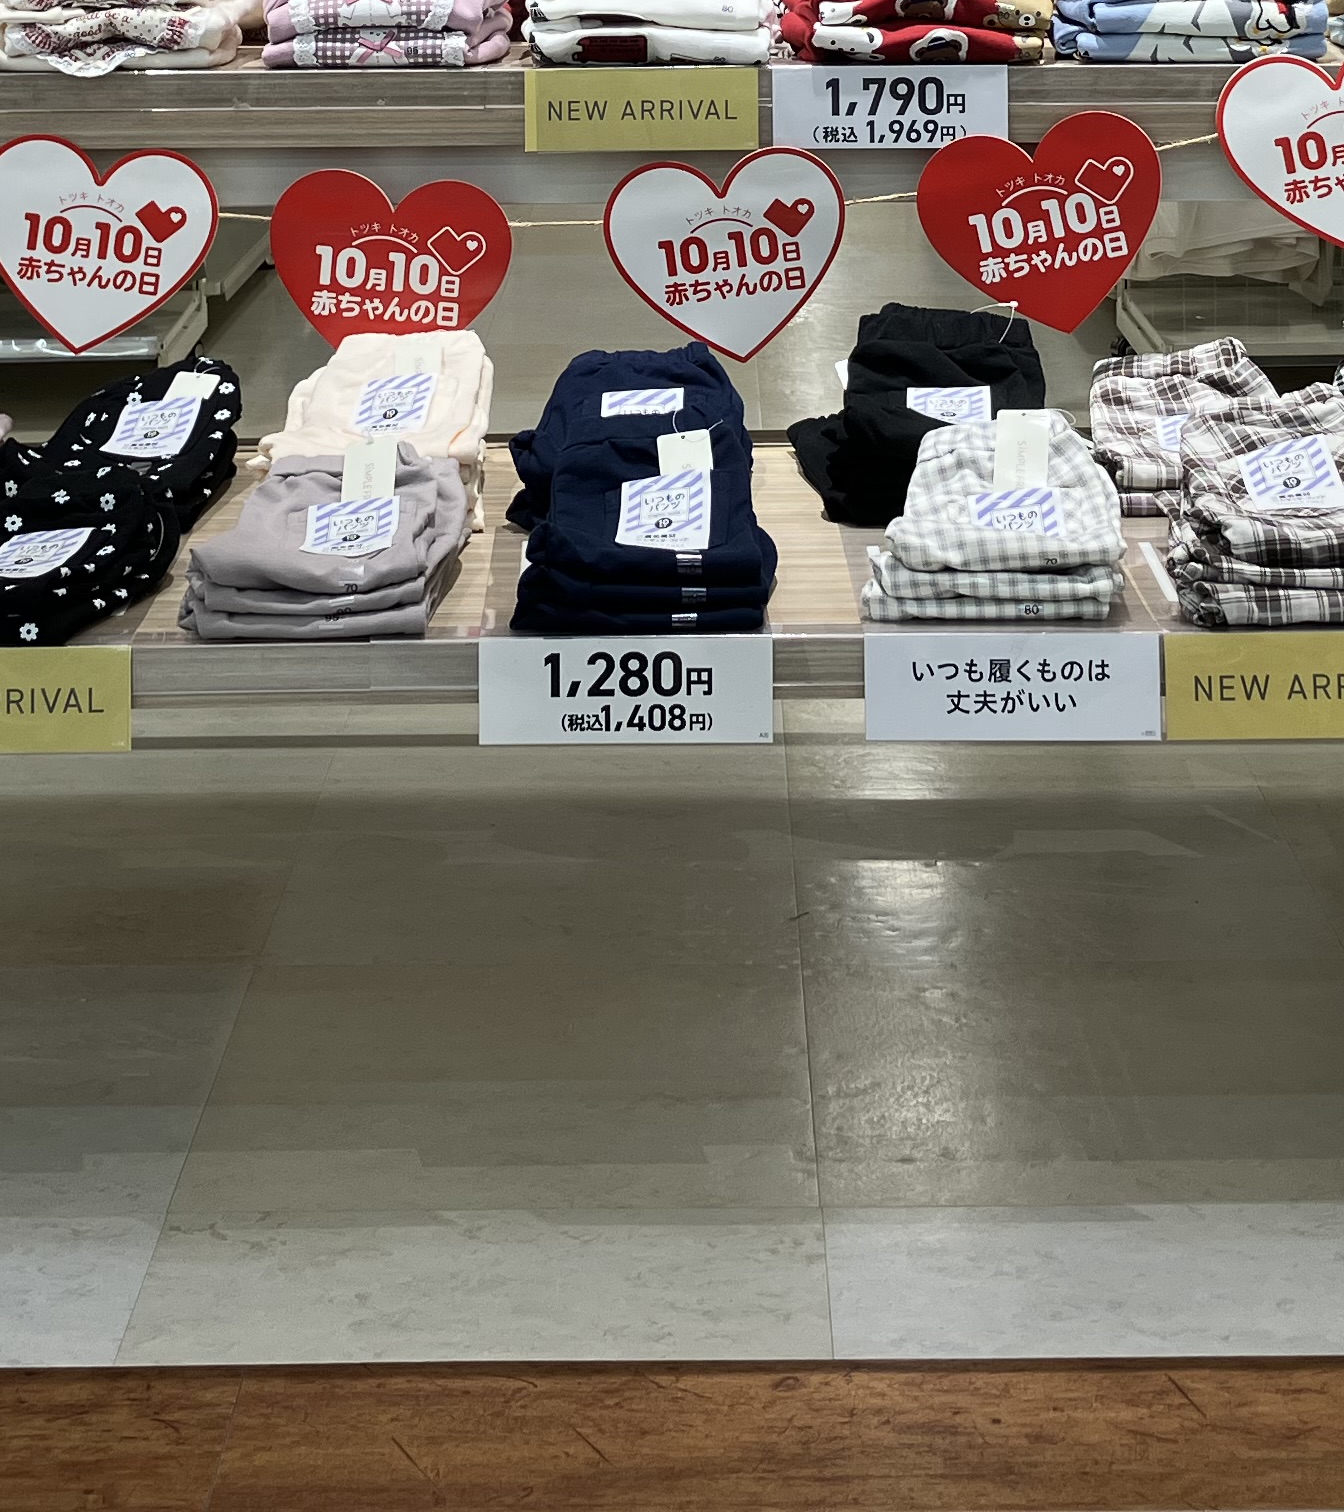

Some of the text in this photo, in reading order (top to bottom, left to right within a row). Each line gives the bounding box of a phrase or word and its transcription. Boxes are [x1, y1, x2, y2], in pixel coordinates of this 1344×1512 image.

[547, 98, 738, 123] NEW ARRIVAL
[824, 76, 966, 117] 1,790円
[812, 126, 858, 144] (税込
[968, 192, 1121, 254] 10月10日
[24, 211, 162, 267] 10月10日
[658, 227, 800, 277] 10月10日
[315, 245, 460, 298] 10月10日
[979, 231, 1129, 285] 赤ちゃんの日
[17, 256, 160, 296] 赤ちゃんの日
[664, 266, 806, 306] 赤ちゃんの日
[310, 290, 459, 327] 赤ちゃんの日
[644, 492, 685, 504] いつもの
[649, 500, 680, 512] パンツ
[333, 515, 375, 526] いつもの
[996, 511, 1037, 523] いつもの
[344, 583, 358, 592] 70
[1024, 604, 1039, 615] 80
[543, 651, 713, 698] 1,280円
[911, 658, 1111, 684] いつも履くものは
[945, 689, 1079, 715] 丈夫がいい
[1193, 674, 1271, 702] NEW
